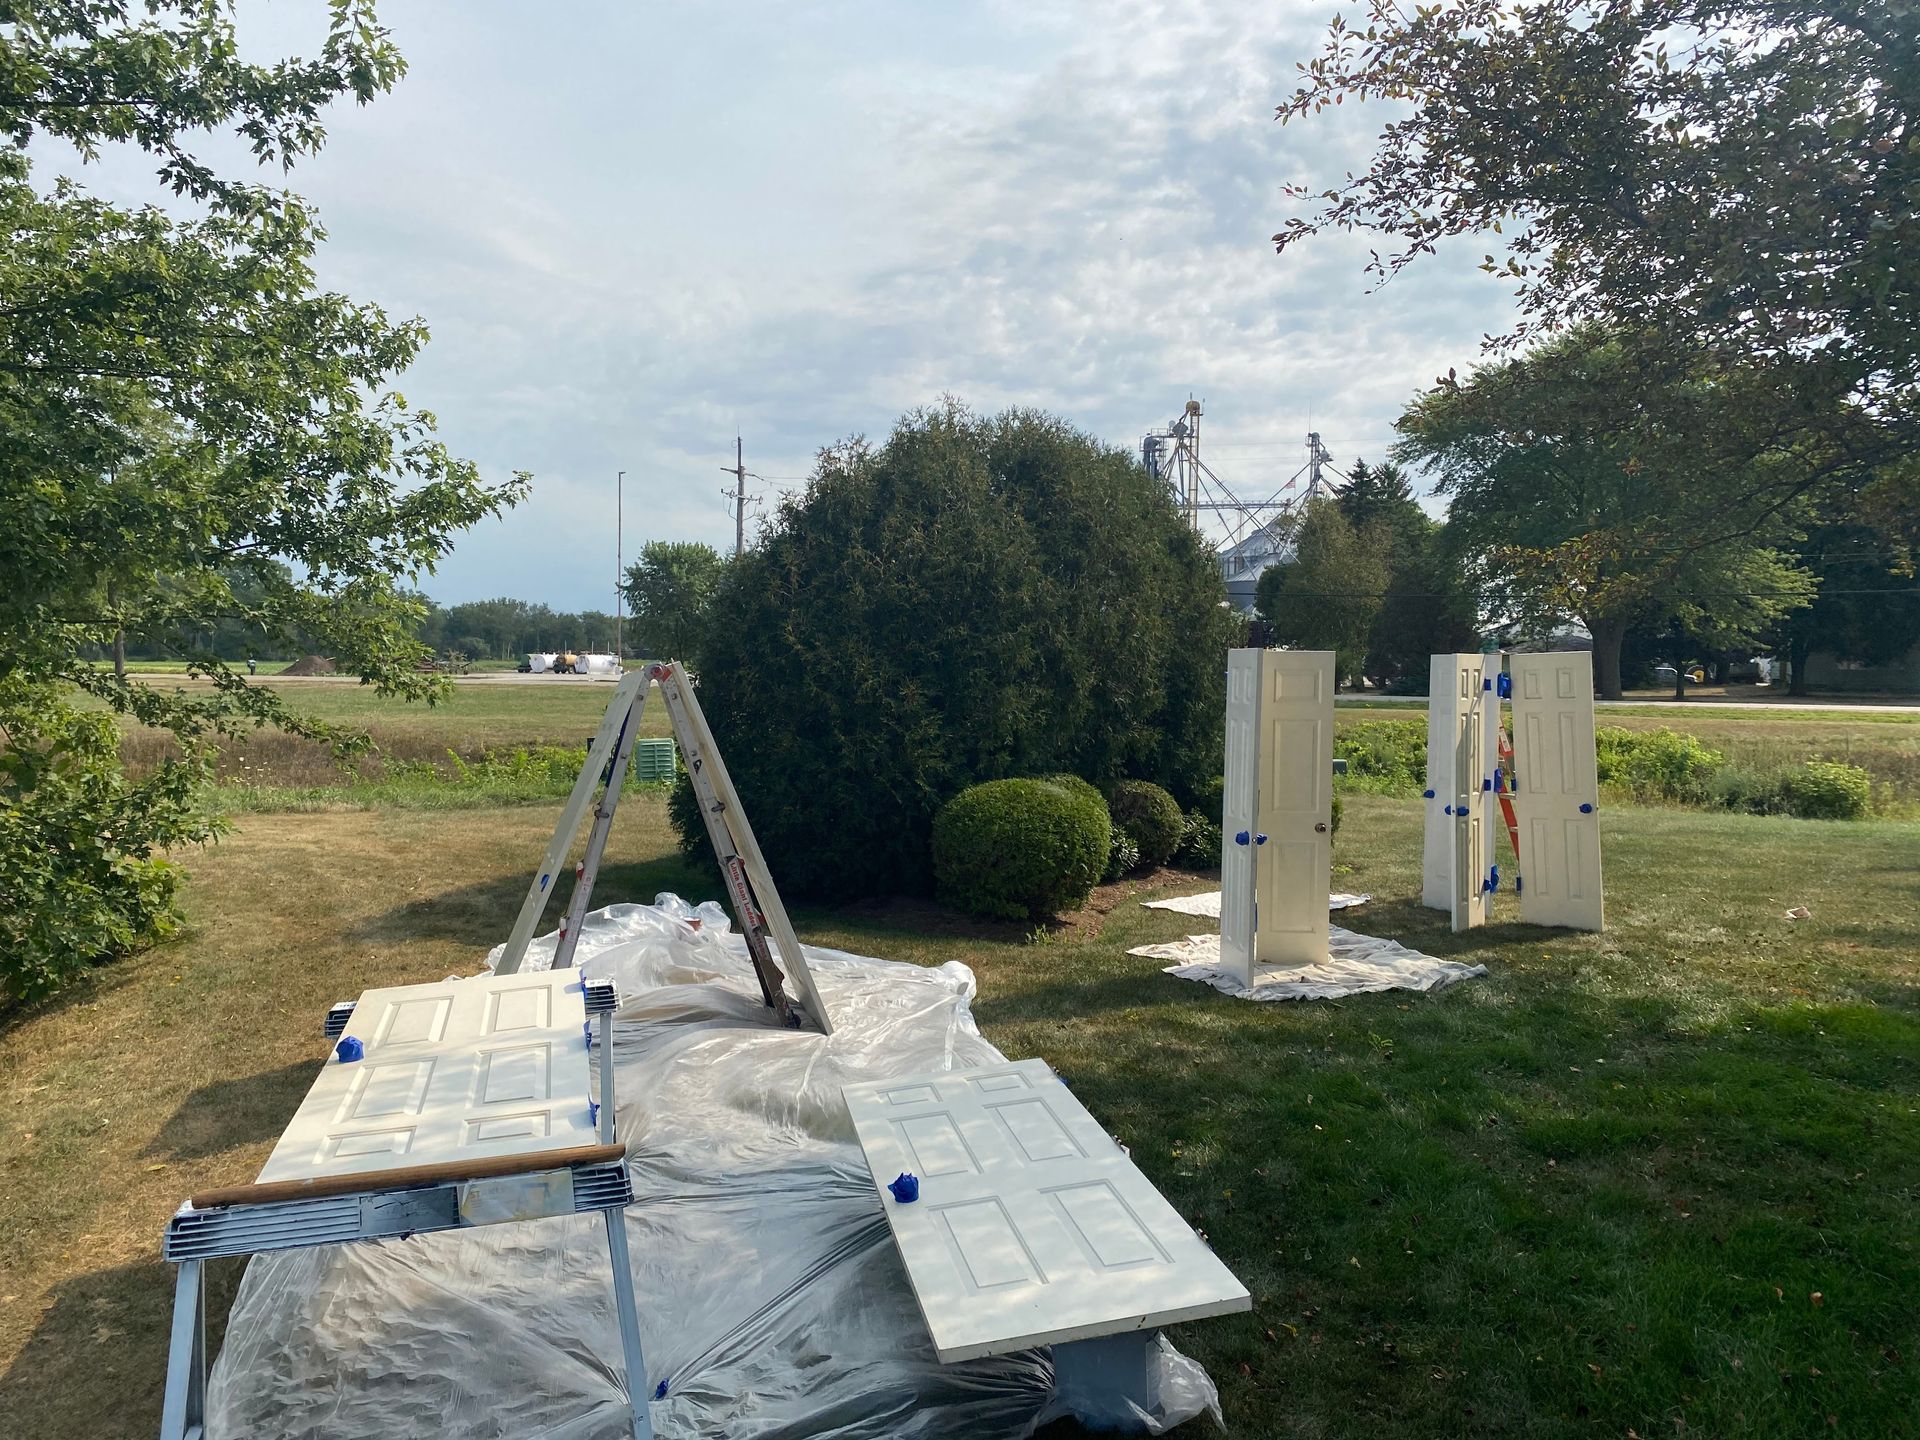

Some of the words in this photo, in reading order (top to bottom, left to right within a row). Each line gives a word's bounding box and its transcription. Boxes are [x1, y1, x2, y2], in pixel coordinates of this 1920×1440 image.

[730, 862, 740, 881] Little
[737, 883, 747, 902] Giant
[744, 902, 757, 926] Ladder
